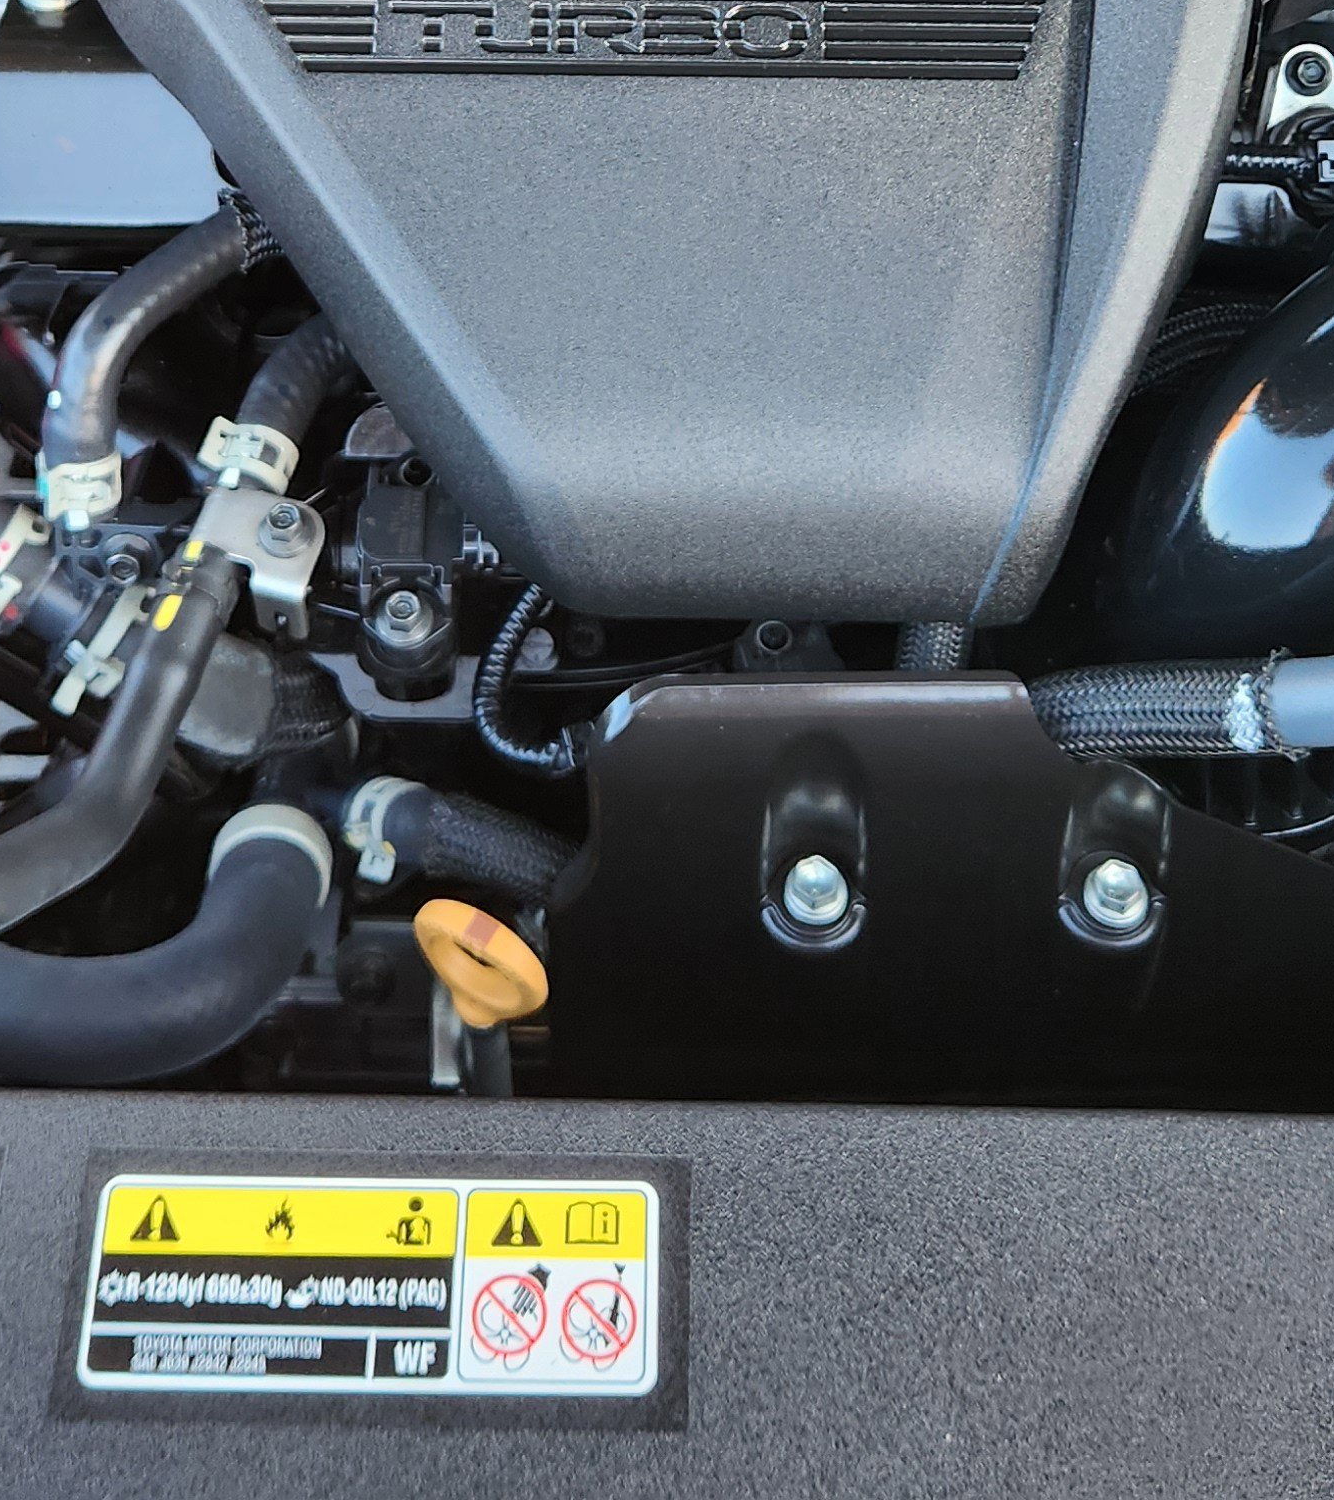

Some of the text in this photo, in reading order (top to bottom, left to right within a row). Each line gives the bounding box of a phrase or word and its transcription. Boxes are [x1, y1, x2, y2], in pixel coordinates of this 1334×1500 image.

[133, 1334, 322, 1359] TOYOTA MOTOR CORPORATION
[393, 1341, 436, 1375] WF
